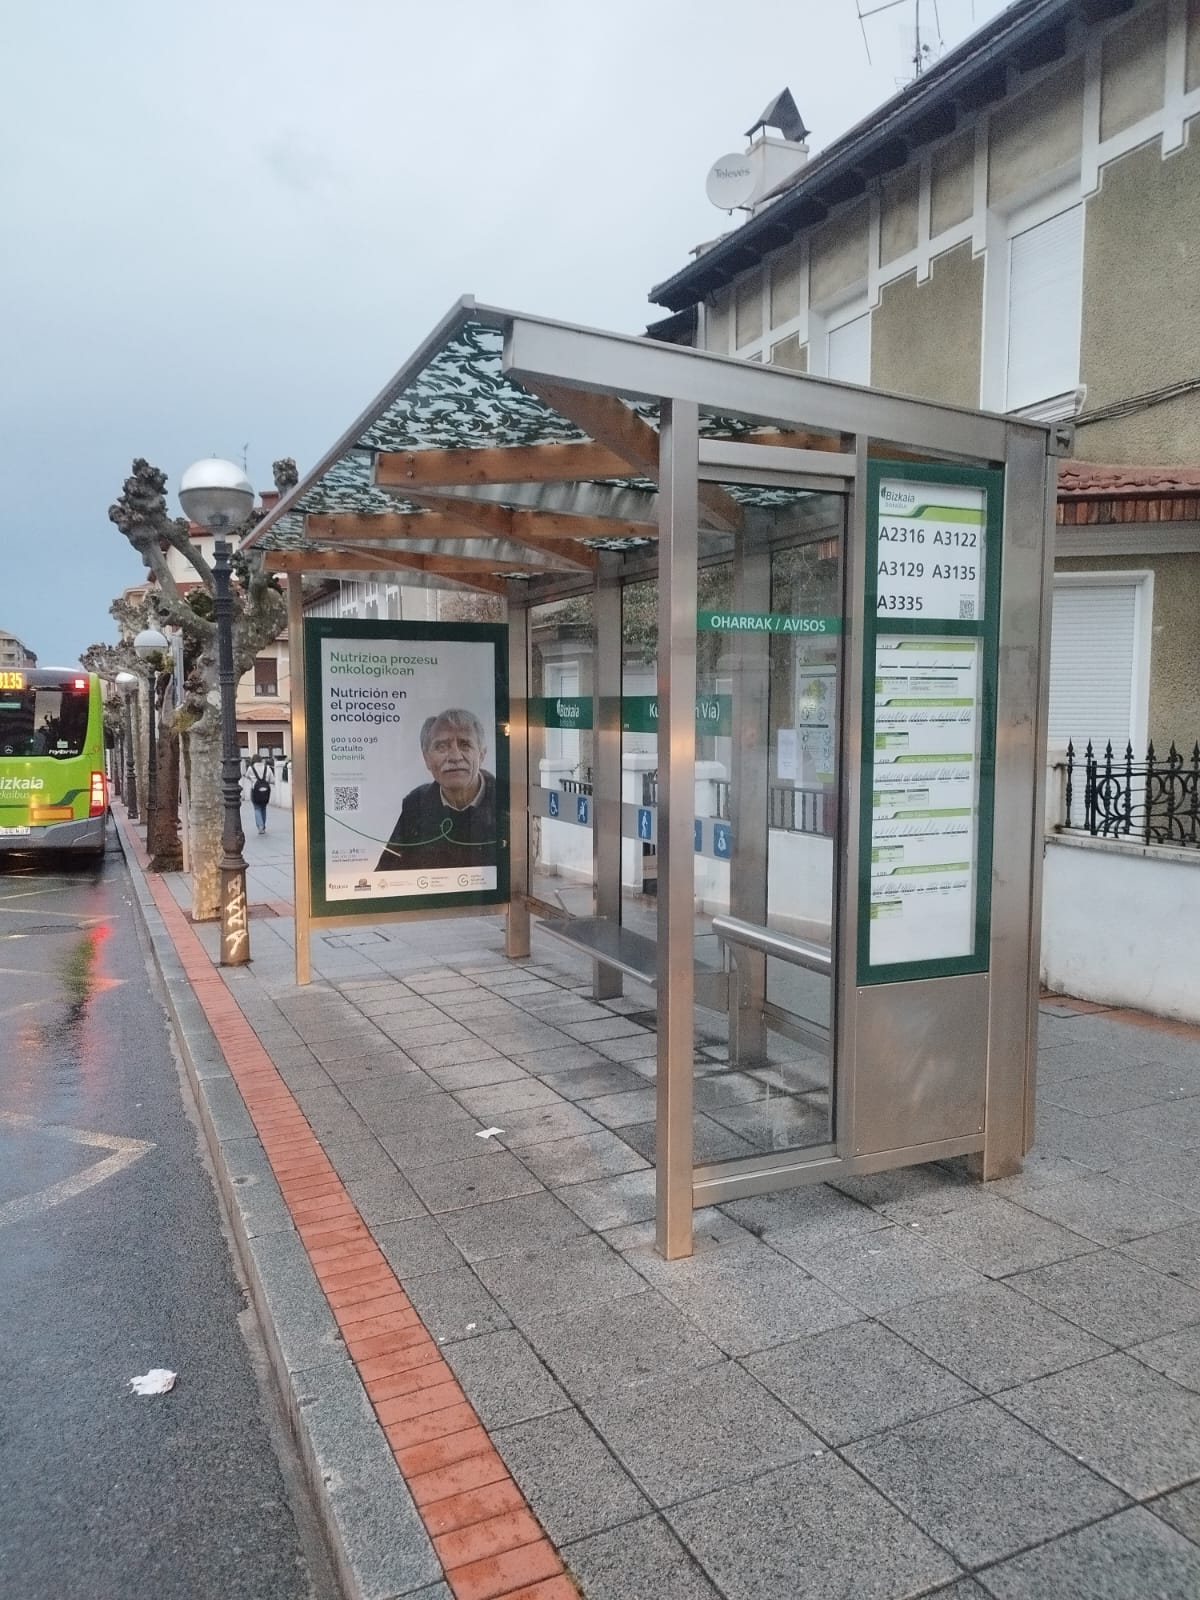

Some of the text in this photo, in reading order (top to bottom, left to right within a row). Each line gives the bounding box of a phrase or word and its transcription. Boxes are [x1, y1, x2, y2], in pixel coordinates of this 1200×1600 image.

[886, 490, 915, 503] Bizkaia
[879, 526, 977, 548] A2316 A3122
[878, 560, 976, 581] A3129 A3135
[877, 594, 923, 611] A3335
[711, 615, 826, 632] OHARRAK / AVISOS
[330, 651, 438, 666] Nutrizioa prozesu
[330, 664, 415, 678] onkologikoan
[330, 687, 407, 699] Nutrición en
[330, 700, 396, 713] el proceso
[330, 712, 401, 725] oncológico
[331, 736, 346, 744] 900
[0, 776, 44, 790] izkaia
